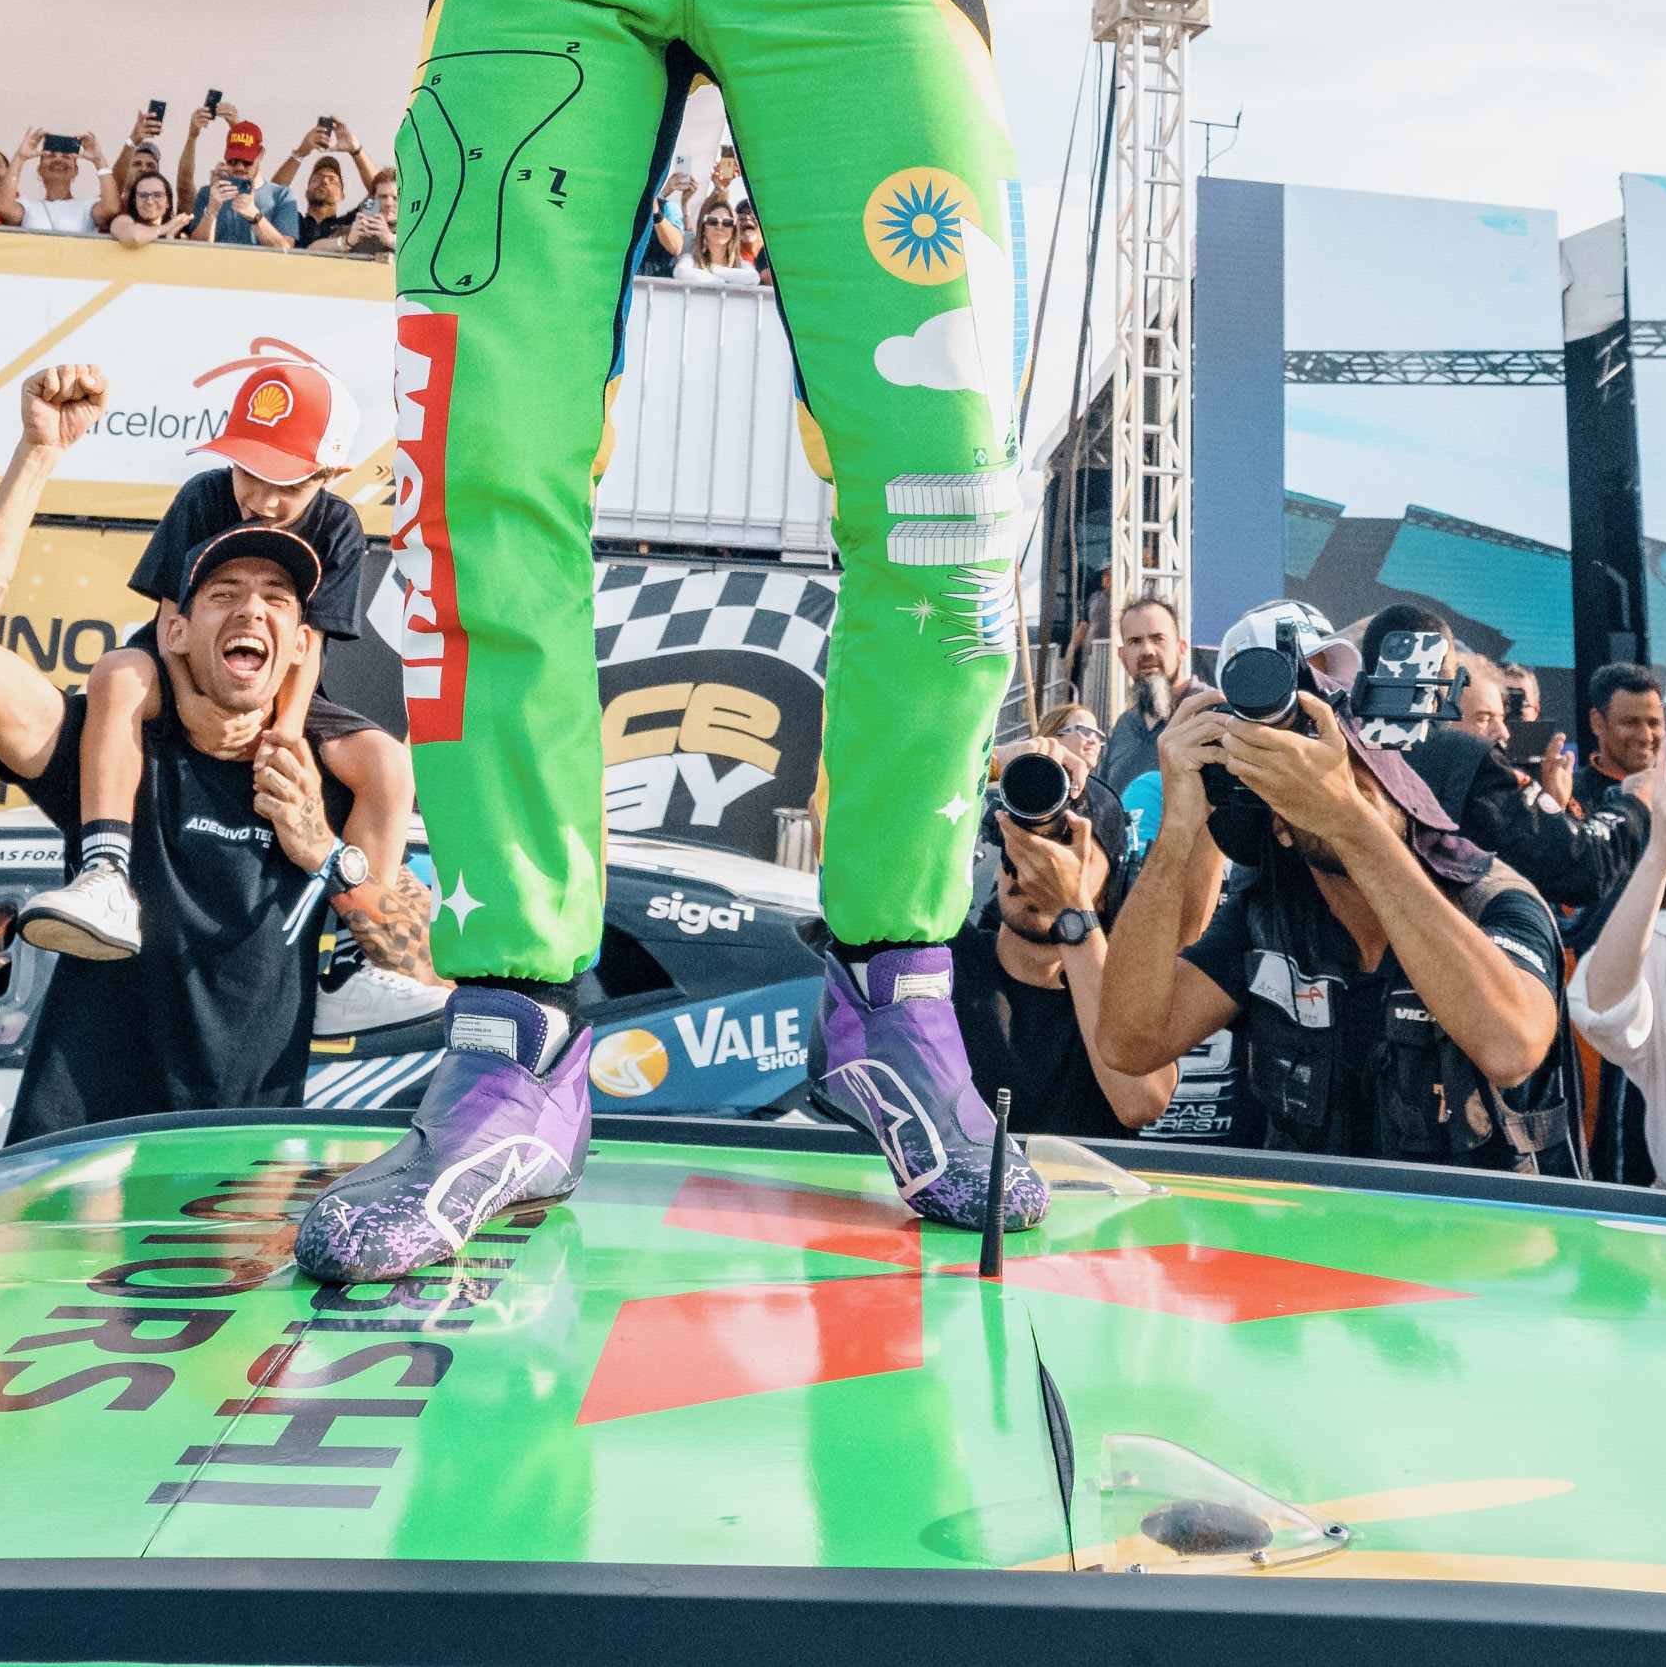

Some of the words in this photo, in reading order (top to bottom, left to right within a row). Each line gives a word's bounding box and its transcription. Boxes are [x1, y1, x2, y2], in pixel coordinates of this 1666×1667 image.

[566, 42, 581, 53] 2
[468, 147, 483, 161] 5
[516, 169, 532, 181] 3
[455, 274, 472, 287] 4
[186, 817, 251, 840] ADESIVO
[646, 891, 743, 935] siga
[674, 1006, 801, 1069] VALE
